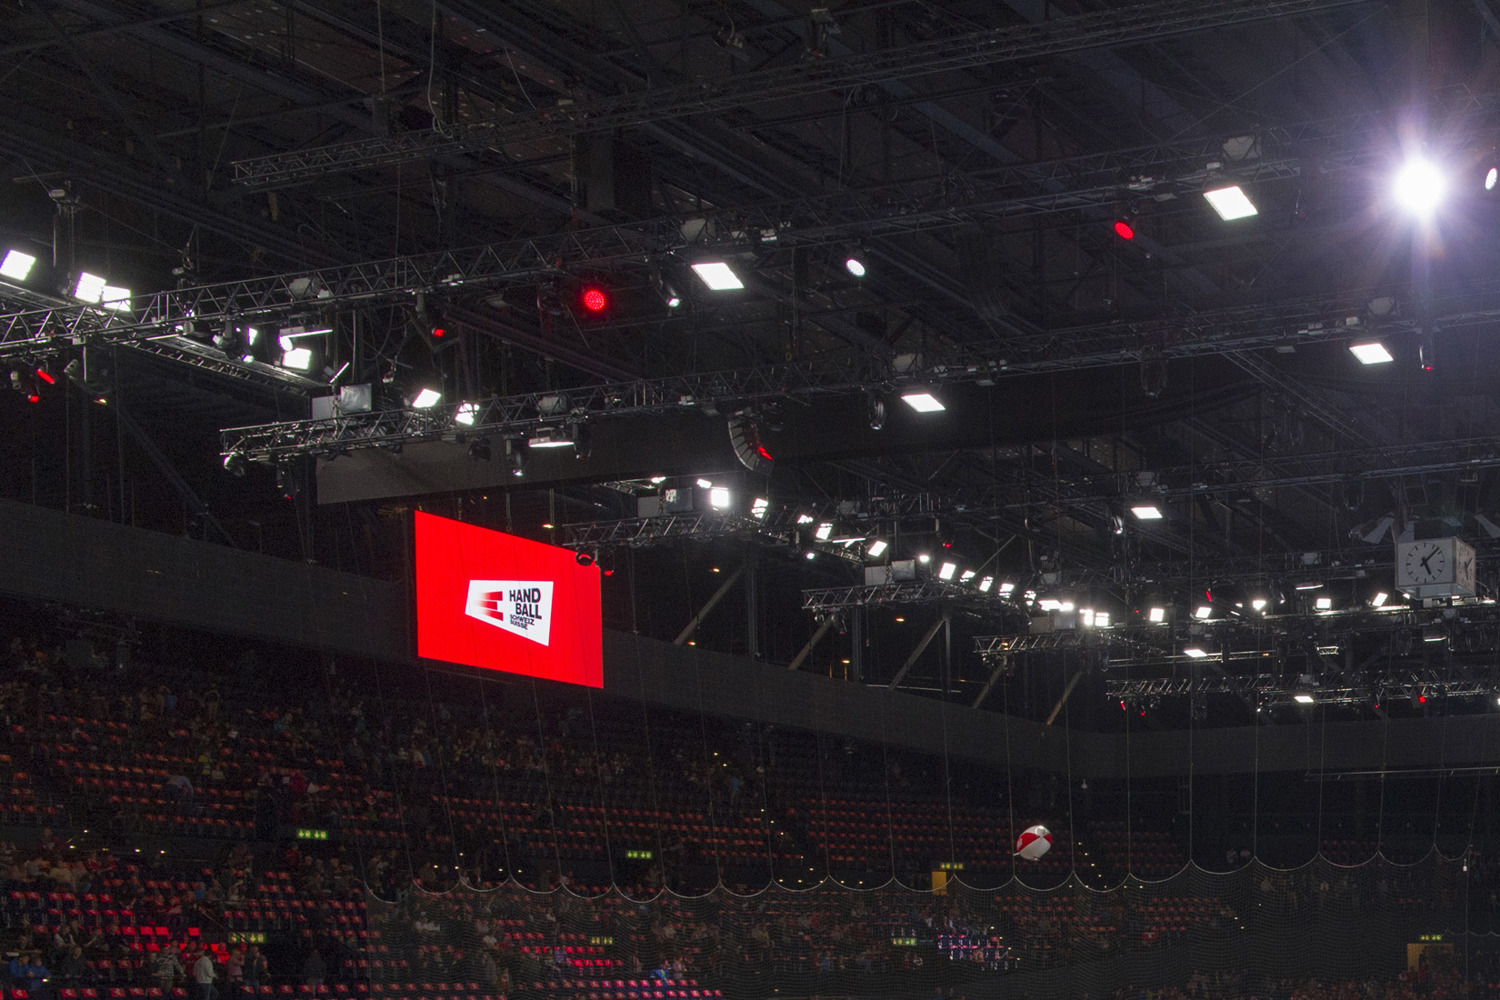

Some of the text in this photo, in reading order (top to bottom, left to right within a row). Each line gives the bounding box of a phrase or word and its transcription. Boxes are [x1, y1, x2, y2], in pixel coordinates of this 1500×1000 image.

[509, 587, 541, 603] HAND
[515, 603, 542, 619] BALL
[510, 614, 535, 625] SCHWEIZ
[510, 620, 529, 630] SUISSE
